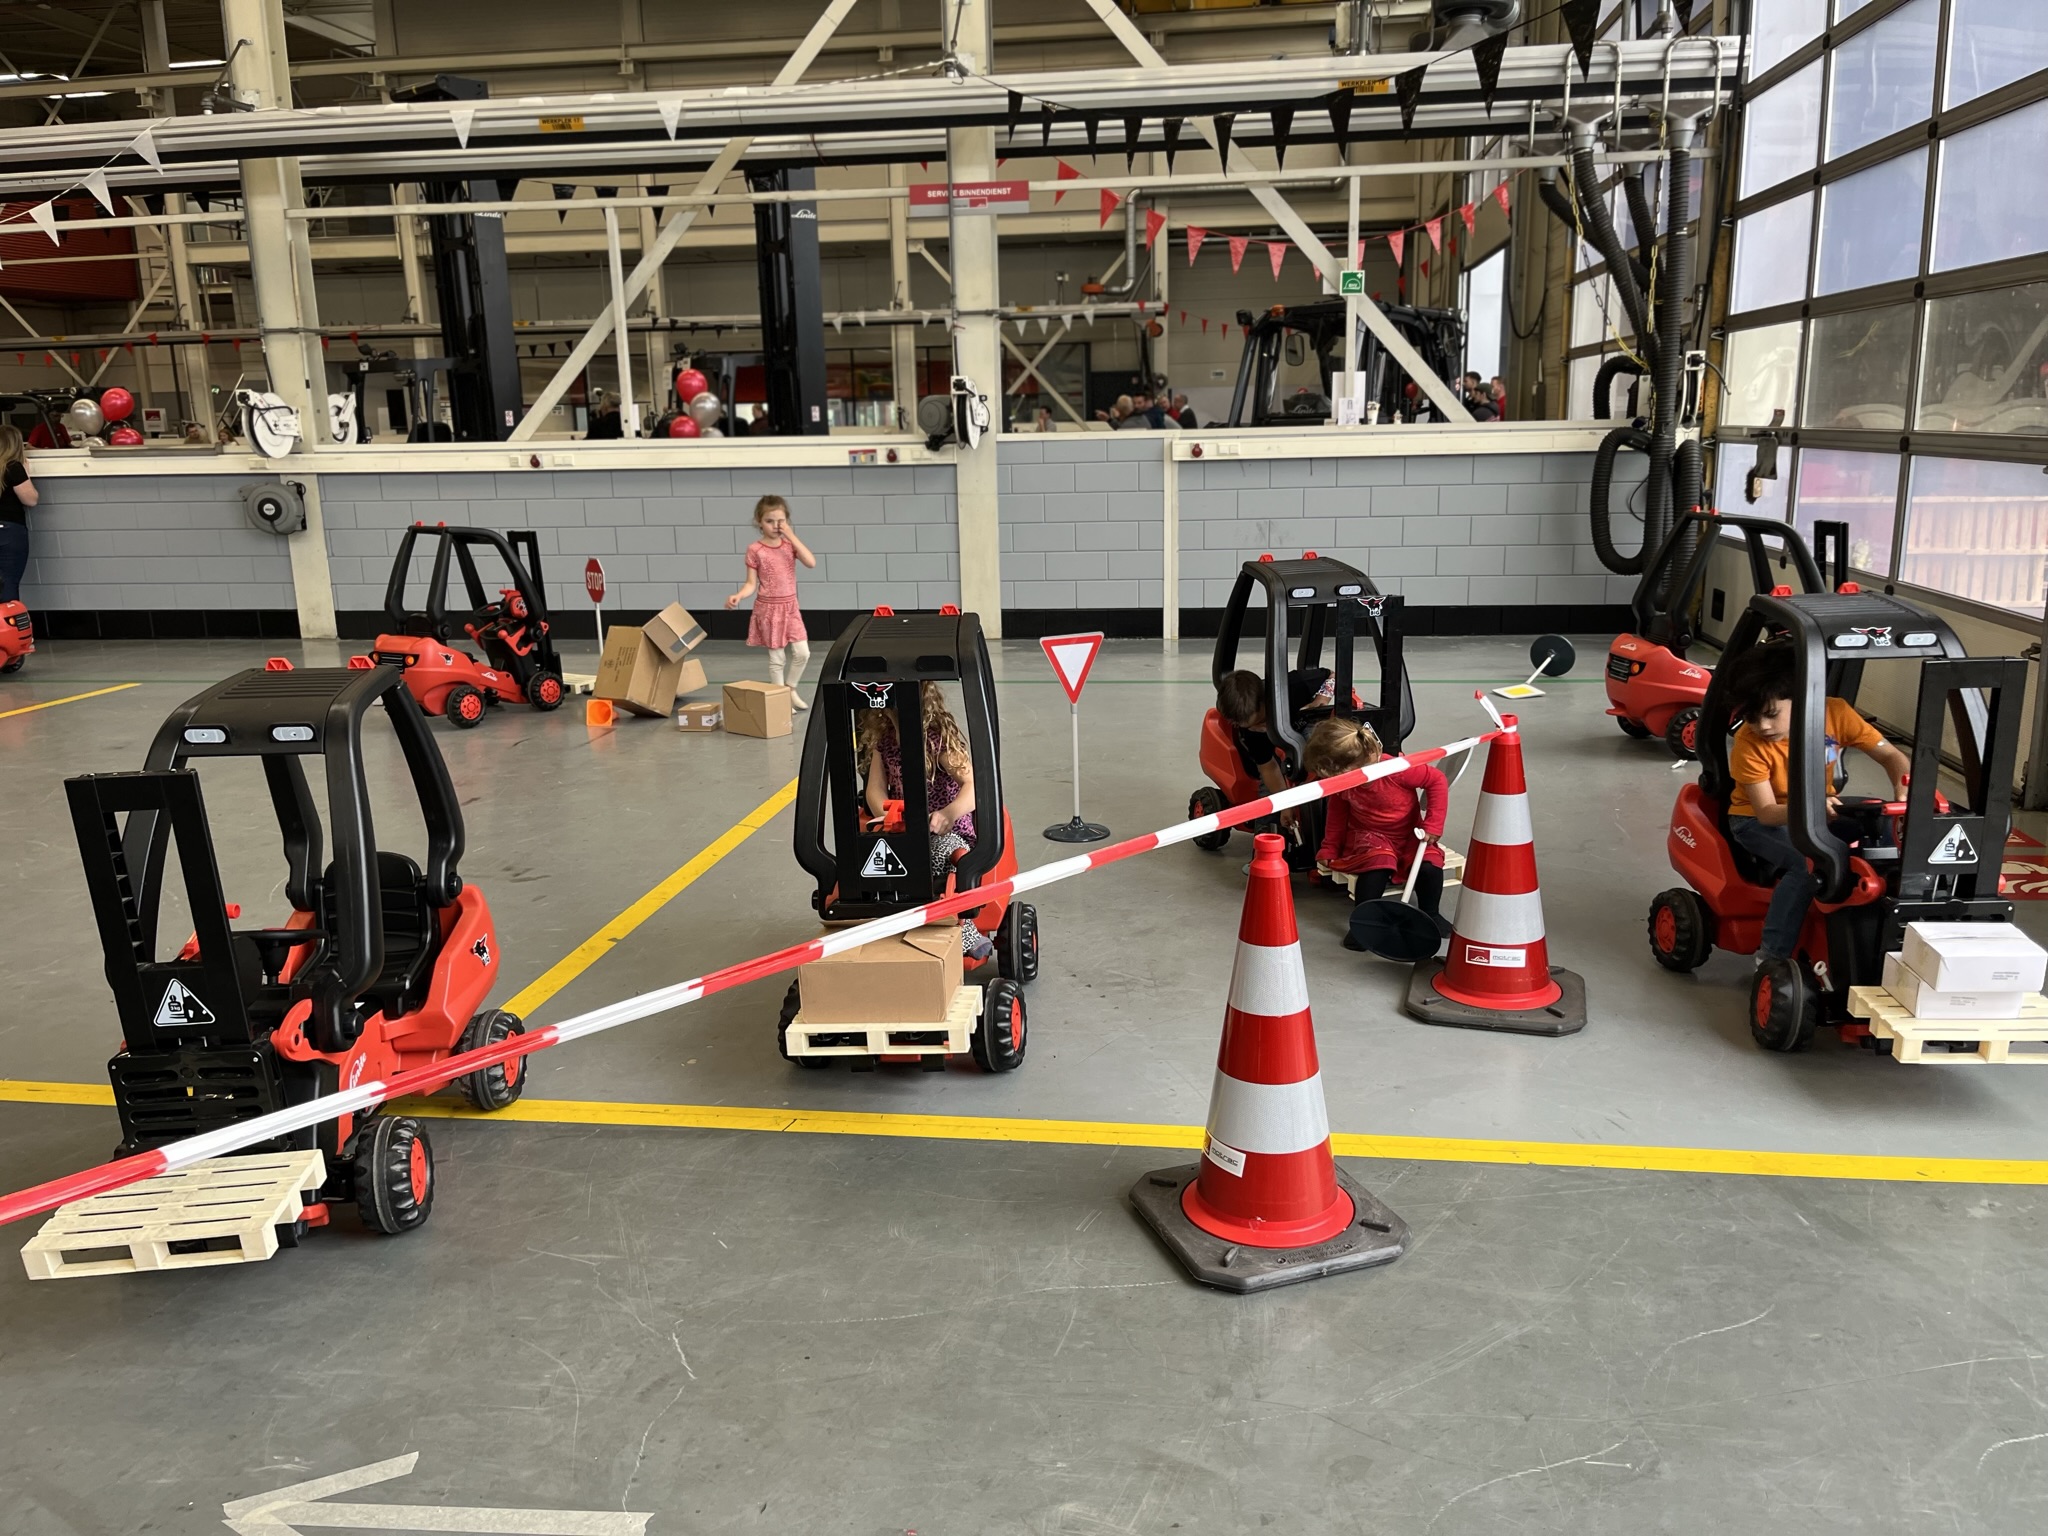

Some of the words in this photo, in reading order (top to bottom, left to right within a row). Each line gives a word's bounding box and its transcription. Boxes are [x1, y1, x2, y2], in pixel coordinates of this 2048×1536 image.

[927, 188, 957, 197] SERVIE
[959, 187, 1011, 197] BINNENDIENST
[791, 208, 816, 219] Linde
[587, 571, 602, 590] STOP
[870, 699, 885, 708] BIG
[1673, 826, 1696, 848] Linde
